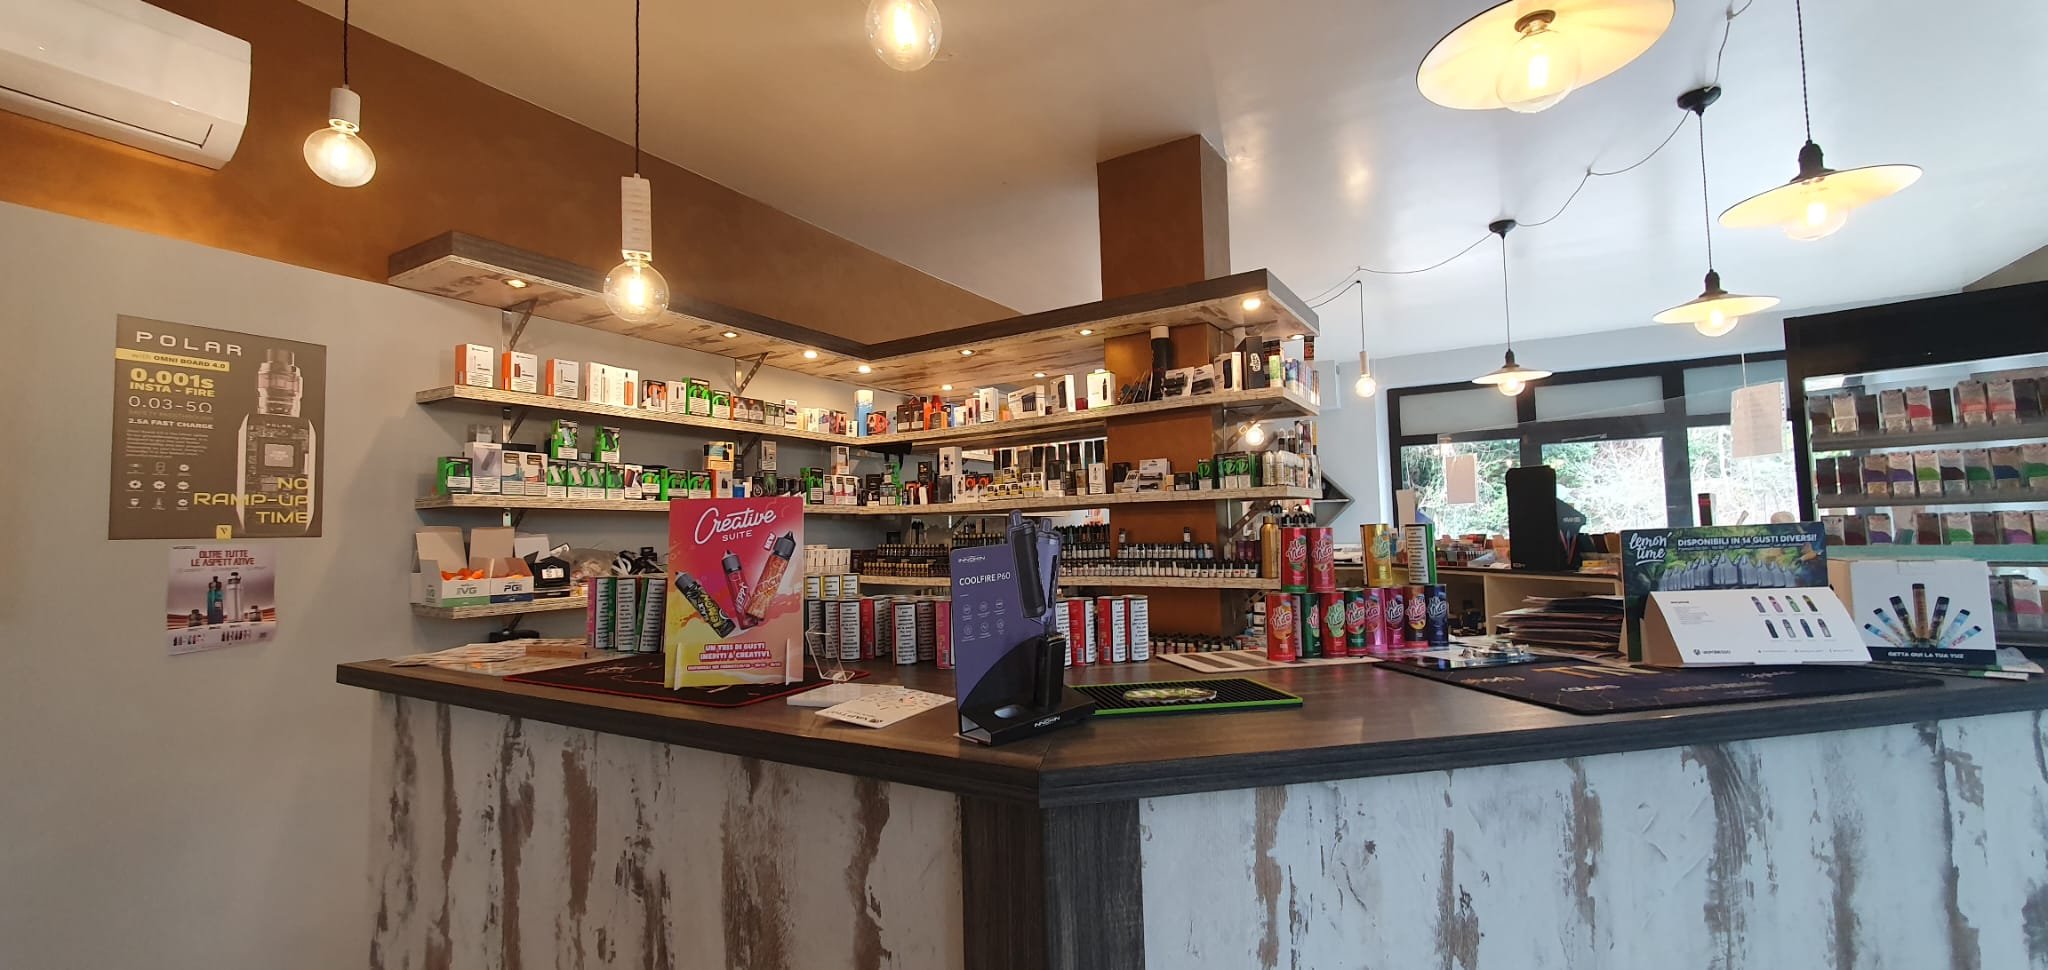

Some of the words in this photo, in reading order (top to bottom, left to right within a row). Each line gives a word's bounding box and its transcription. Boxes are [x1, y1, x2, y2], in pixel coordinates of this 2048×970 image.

[135, 331, 242, 357] POLAR
[153, 355, 178, 363] OMNI
[180, 358, 210, 367] BOARD
[130, 367, 215, 389] 0.001s
[130, 382, 172, 394] INSTA
[185, 387, 215, 398] FIRE
[151, 419, 175, 427] FAST
[177, 421, 214, 430] CHARGE
[277, 477, 308, 489] NO
[256, 511, 309, 524] TIME
[694, 507, 777, 545] Creative
[721, 529, 753, 542] SUITE
[1677, 536, 1730, 547] DISPONIBILI
[1731, 536, 1741, 546] IN
[1753, 534, 1779, 545] GUSTI
[199, 550, 222, 558] OLTRE
[225, 549, 248, 558] TUTTE
[1636, 546, 1666, 560] time
[191, 559, 200, 567] LE
[959, 573, 996, 586] COOLFIRE
[997, 571, 1011, 581] P60
[743, 642, 765, 650] GUSTI
[700, 652, 727, 660] INEDITI
[736, 651, 770, 659] CREATIVI
